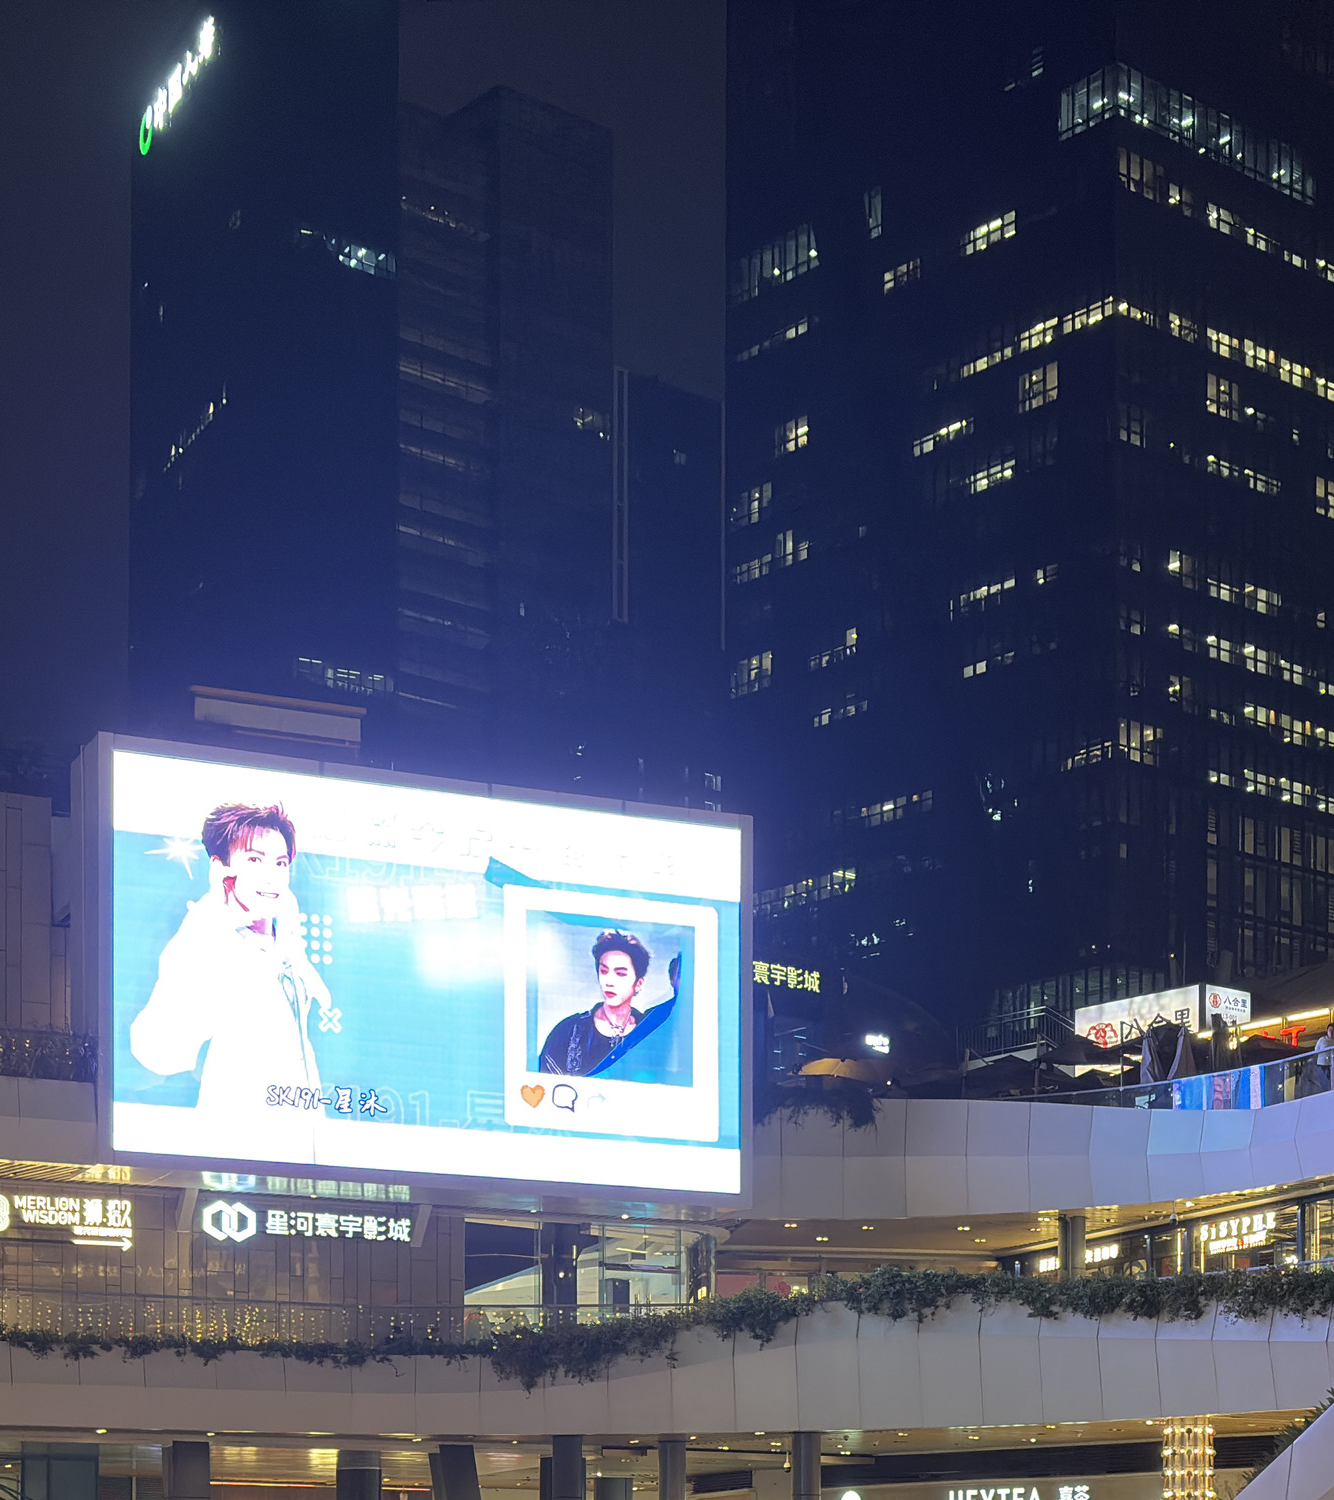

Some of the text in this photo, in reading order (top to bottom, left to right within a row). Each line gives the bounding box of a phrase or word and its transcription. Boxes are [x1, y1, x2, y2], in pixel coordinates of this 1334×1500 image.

[752, 961, 821, 993] 寰宇影城
[14, 1195, 80, 1212] MERLION
[21, 1209, 80, 1226] WISDOM
[266, 1209, 411, 1243] 星河寰宇影城
